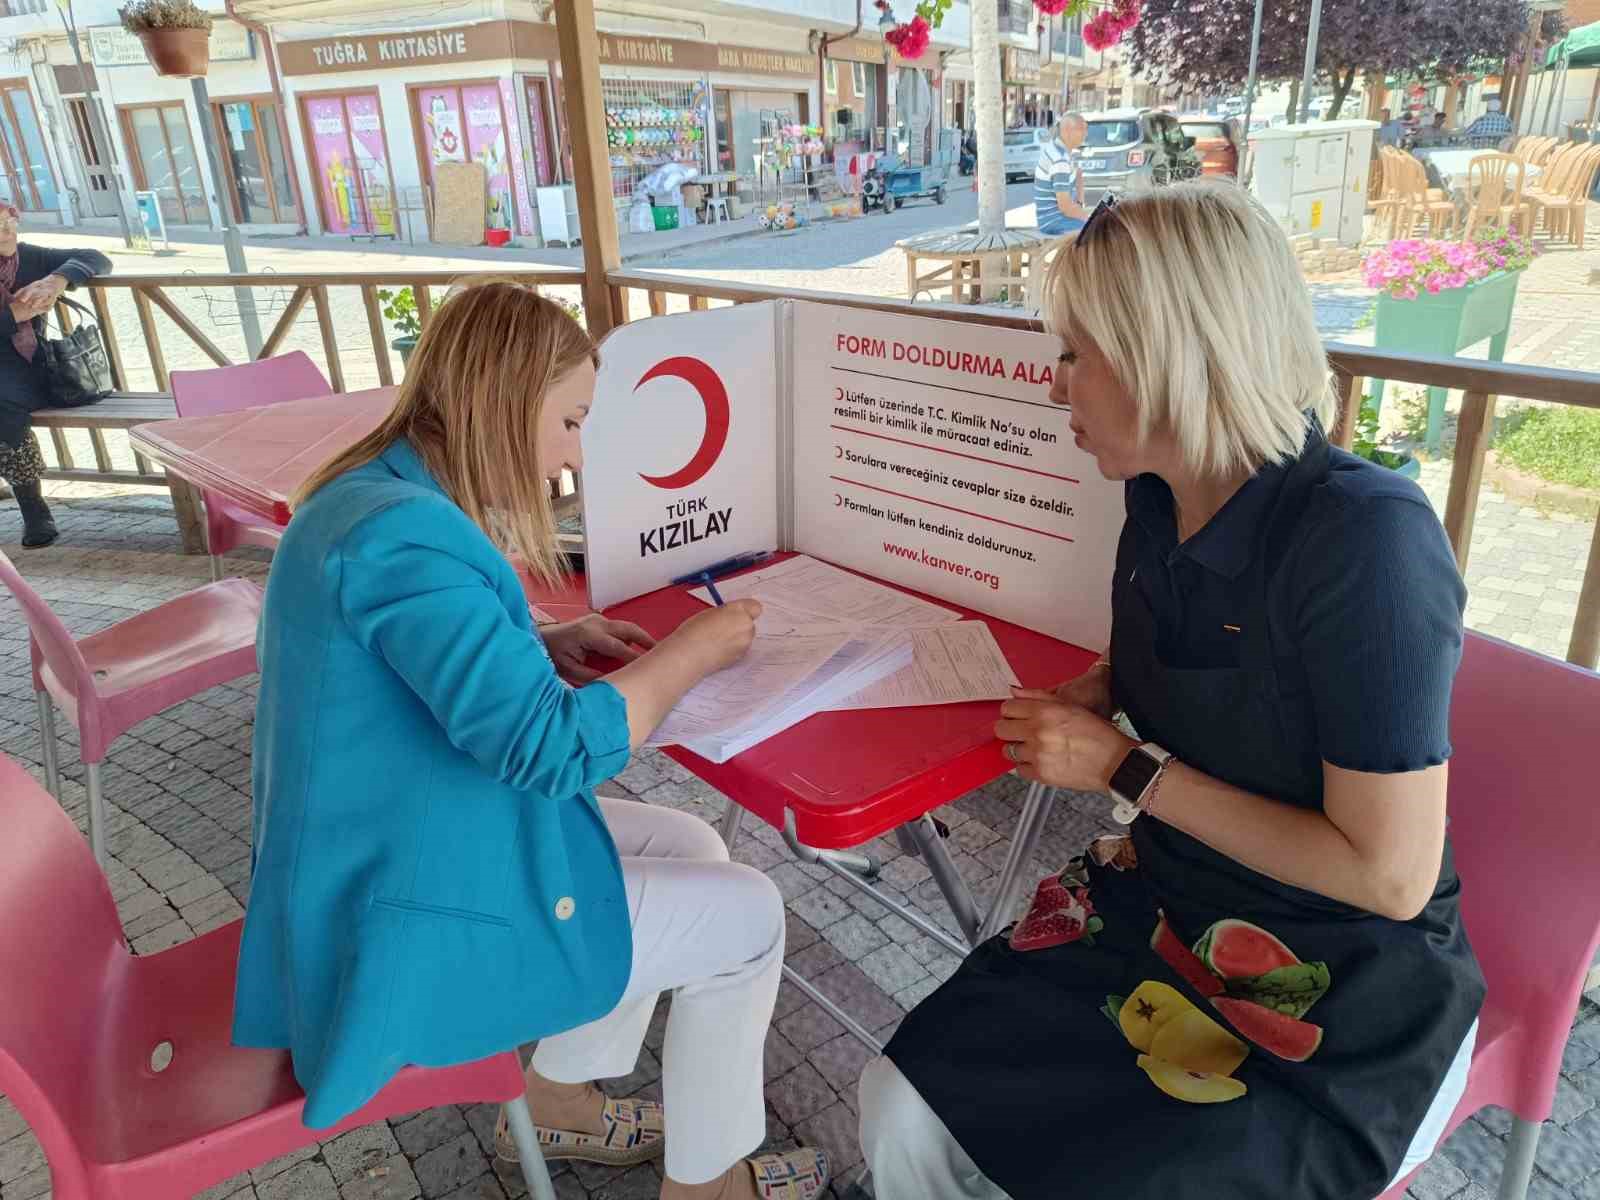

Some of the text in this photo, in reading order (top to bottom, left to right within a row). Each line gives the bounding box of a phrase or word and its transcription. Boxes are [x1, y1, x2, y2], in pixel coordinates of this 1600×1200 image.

[312, 30, 467, 66] TUĞRA KIRTASİYE
[836, 334, 1054, 385] FORM DOLDURMA ALA
[834, 406, 1034, 457] resimli bir kimlik ile müracaat ediniz.
[846, 389, 876, 406] Lütfen
[879, 396, 925, 416] üzerinde
[927, 405, 948, 422] T.C.
[951, 410, 987, 429] Kimlik
[1029, 427, 1058, 444] olan
[665, 496, 708, 520] TÜRK
[845, 451, 1076, 517] Sorulara vereceğiniz cevaplar size özeldir.
[639, 507, 733, 557] KIZILAY
[887, 509, 917, 528] lütfen
[919, 517, 965, 542] kendiniz
[967, 532, 1038, 563] doldurunuz.
[882, 540, 1001, 590] www.kanver.org
